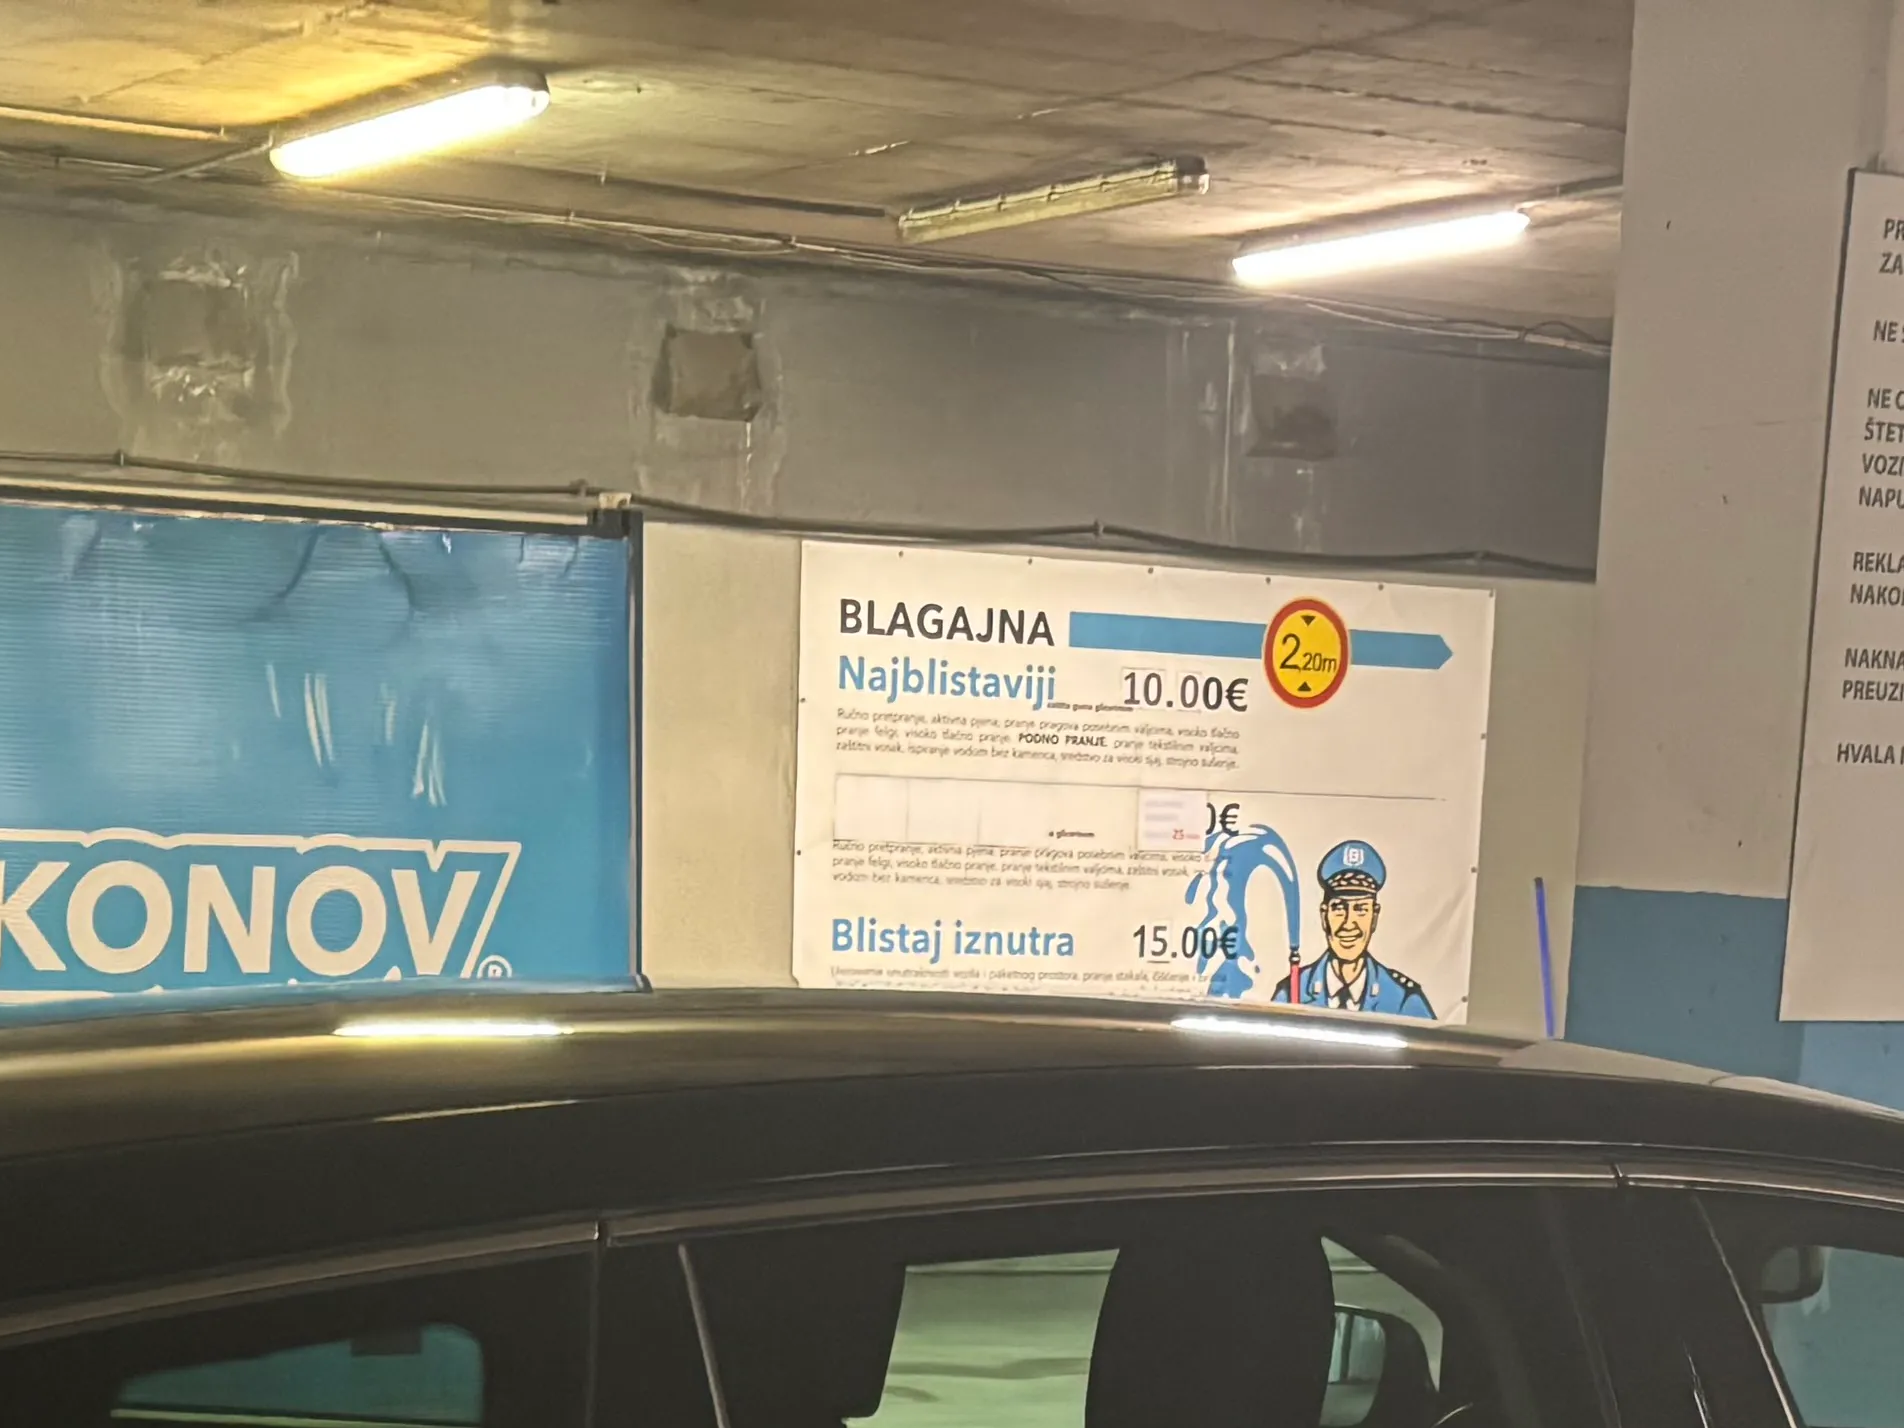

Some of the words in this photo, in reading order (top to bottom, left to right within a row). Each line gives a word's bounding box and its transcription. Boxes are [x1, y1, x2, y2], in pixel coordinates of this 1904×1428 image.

[1879, 252, 1903, 275] ZA
[1873, 320, 1898, 342] NE
[1867, 388, 1892, 408] NE
[840, 598, 1055, 647] BLAGAJNA
[839, 655, 1055, 711] Najblistaviji
[1123, 670, 1249, 713] 10.00€
[1019, 732, 1059, 745] PODNO
[1837, 743, 1894, 764] HVALA
[832, 917, 941, 964] Blistaj
[954, 919, 1074, 957] iznutra
[1133, 924, 1239, 960] 15.00€
